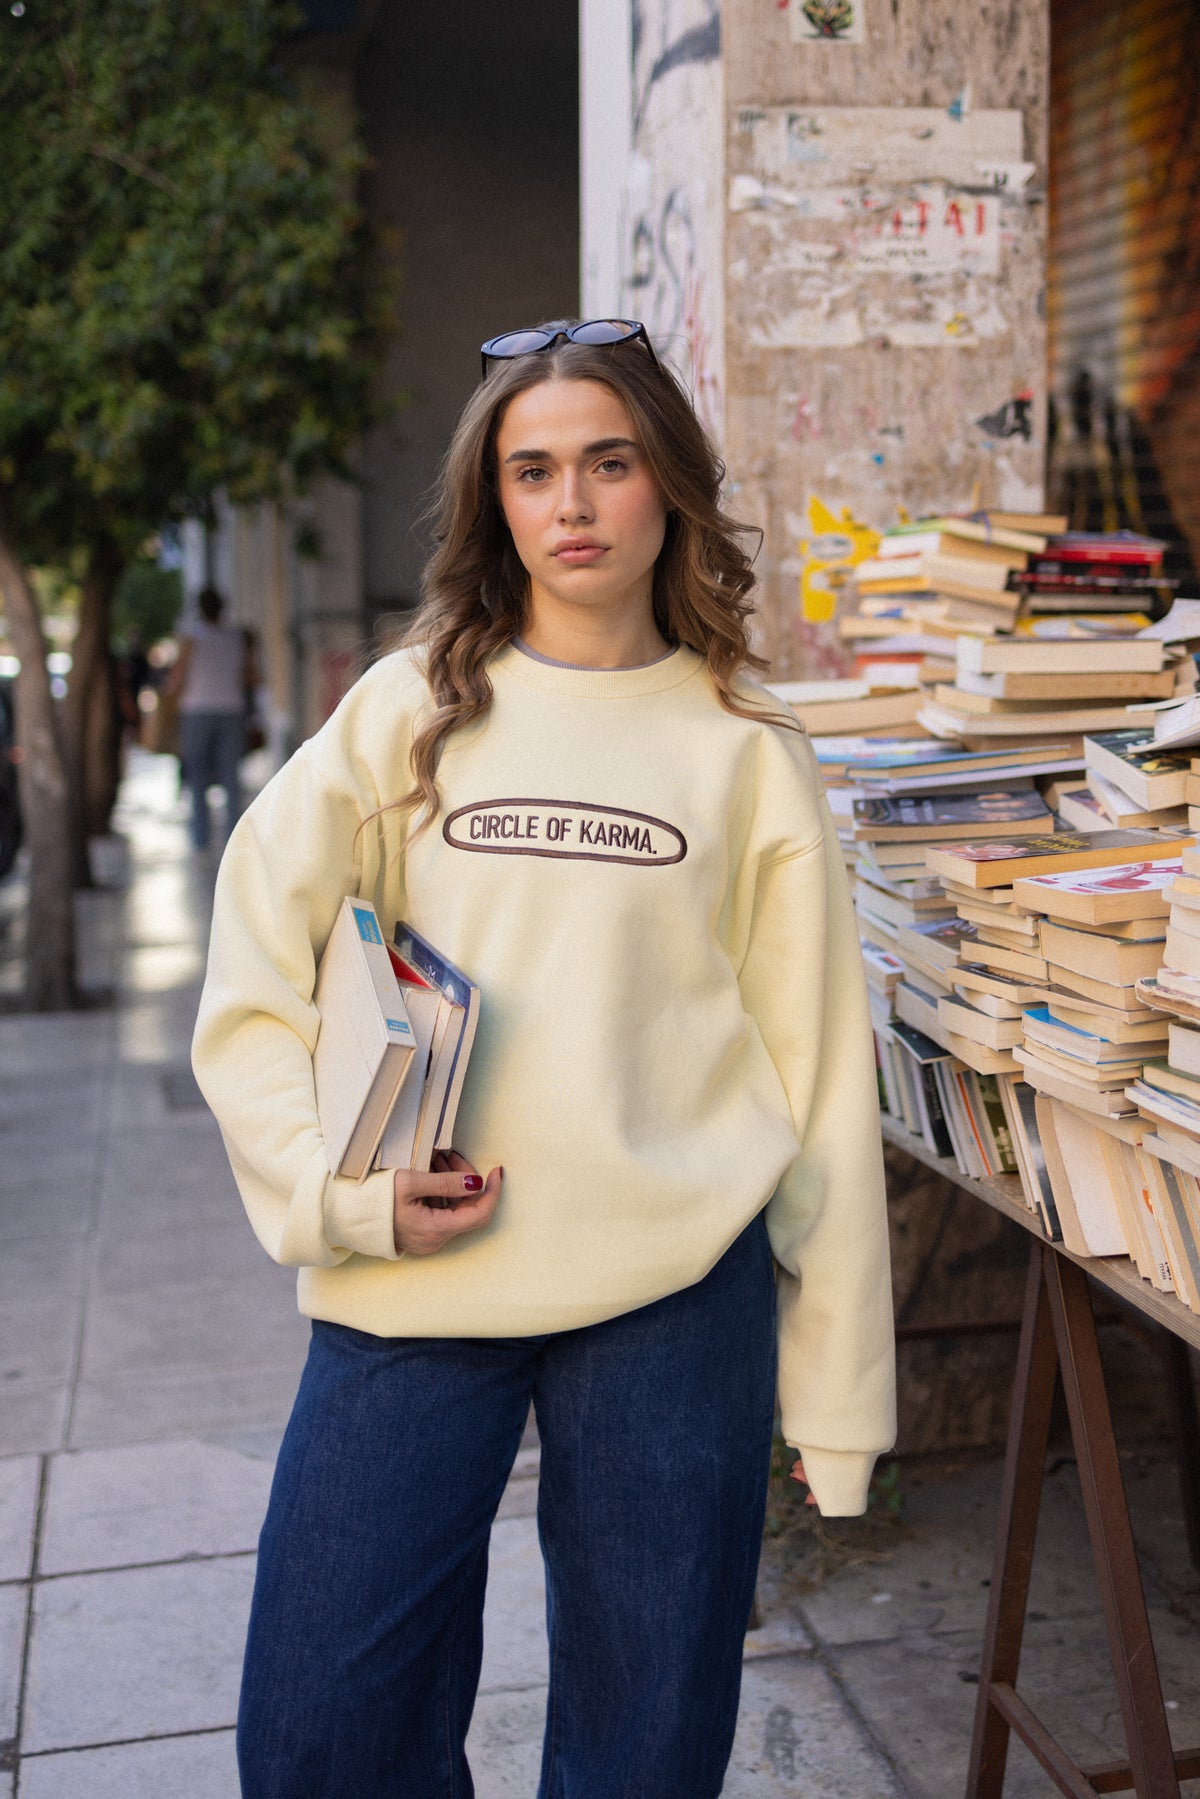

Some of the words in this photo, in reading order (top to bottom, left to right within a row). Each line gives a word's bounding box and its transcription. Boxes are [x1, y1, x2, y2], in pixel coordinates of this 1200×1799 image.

[469, 814, 539, 840] CIRCLE
[546, 816, 572, 842] OF
[579, 819, 657, 855] KARMA.
